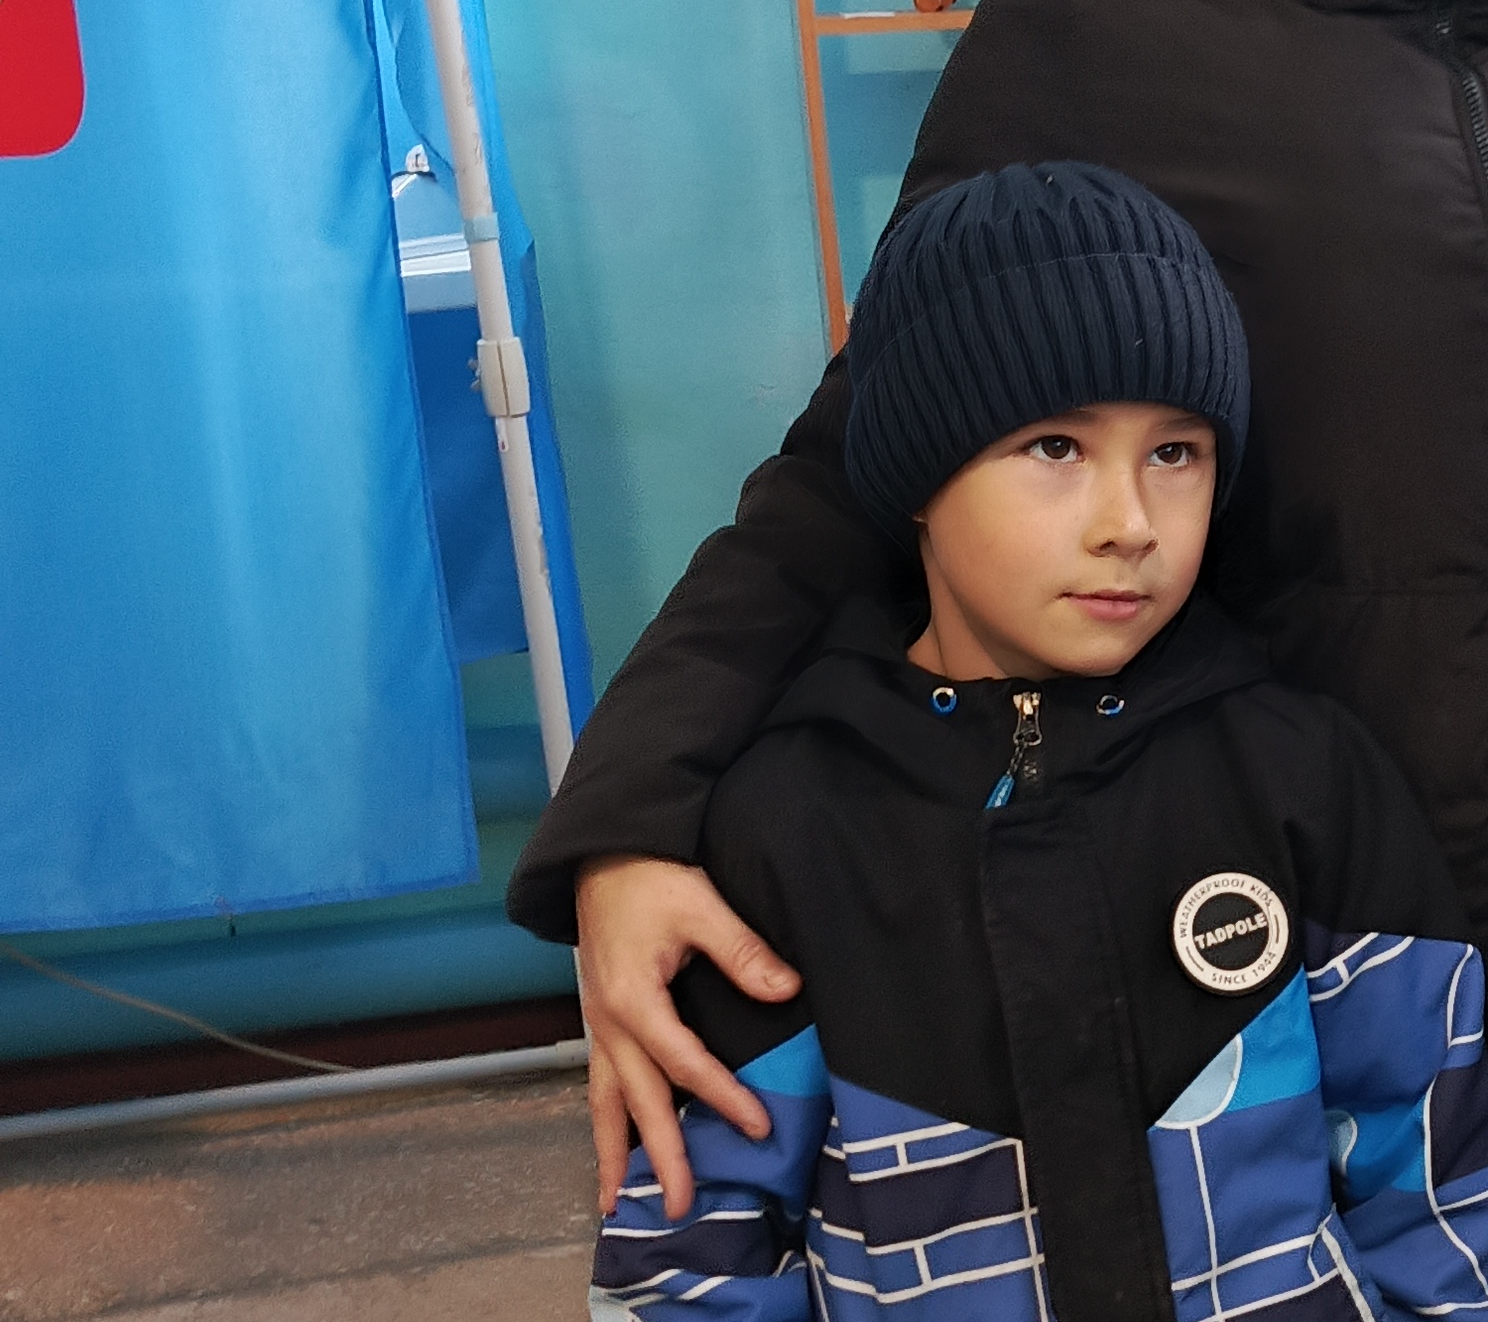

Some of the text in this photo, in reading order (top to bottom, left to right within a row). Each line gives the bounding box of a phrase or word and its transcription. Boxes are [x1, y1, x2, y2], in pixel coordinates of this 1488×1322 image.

[1249, 883, 1273, 907] KIDS
[1194, 912, 1268, 950] TADPOLE
[1212, 972, 1247, 985] SINCE
